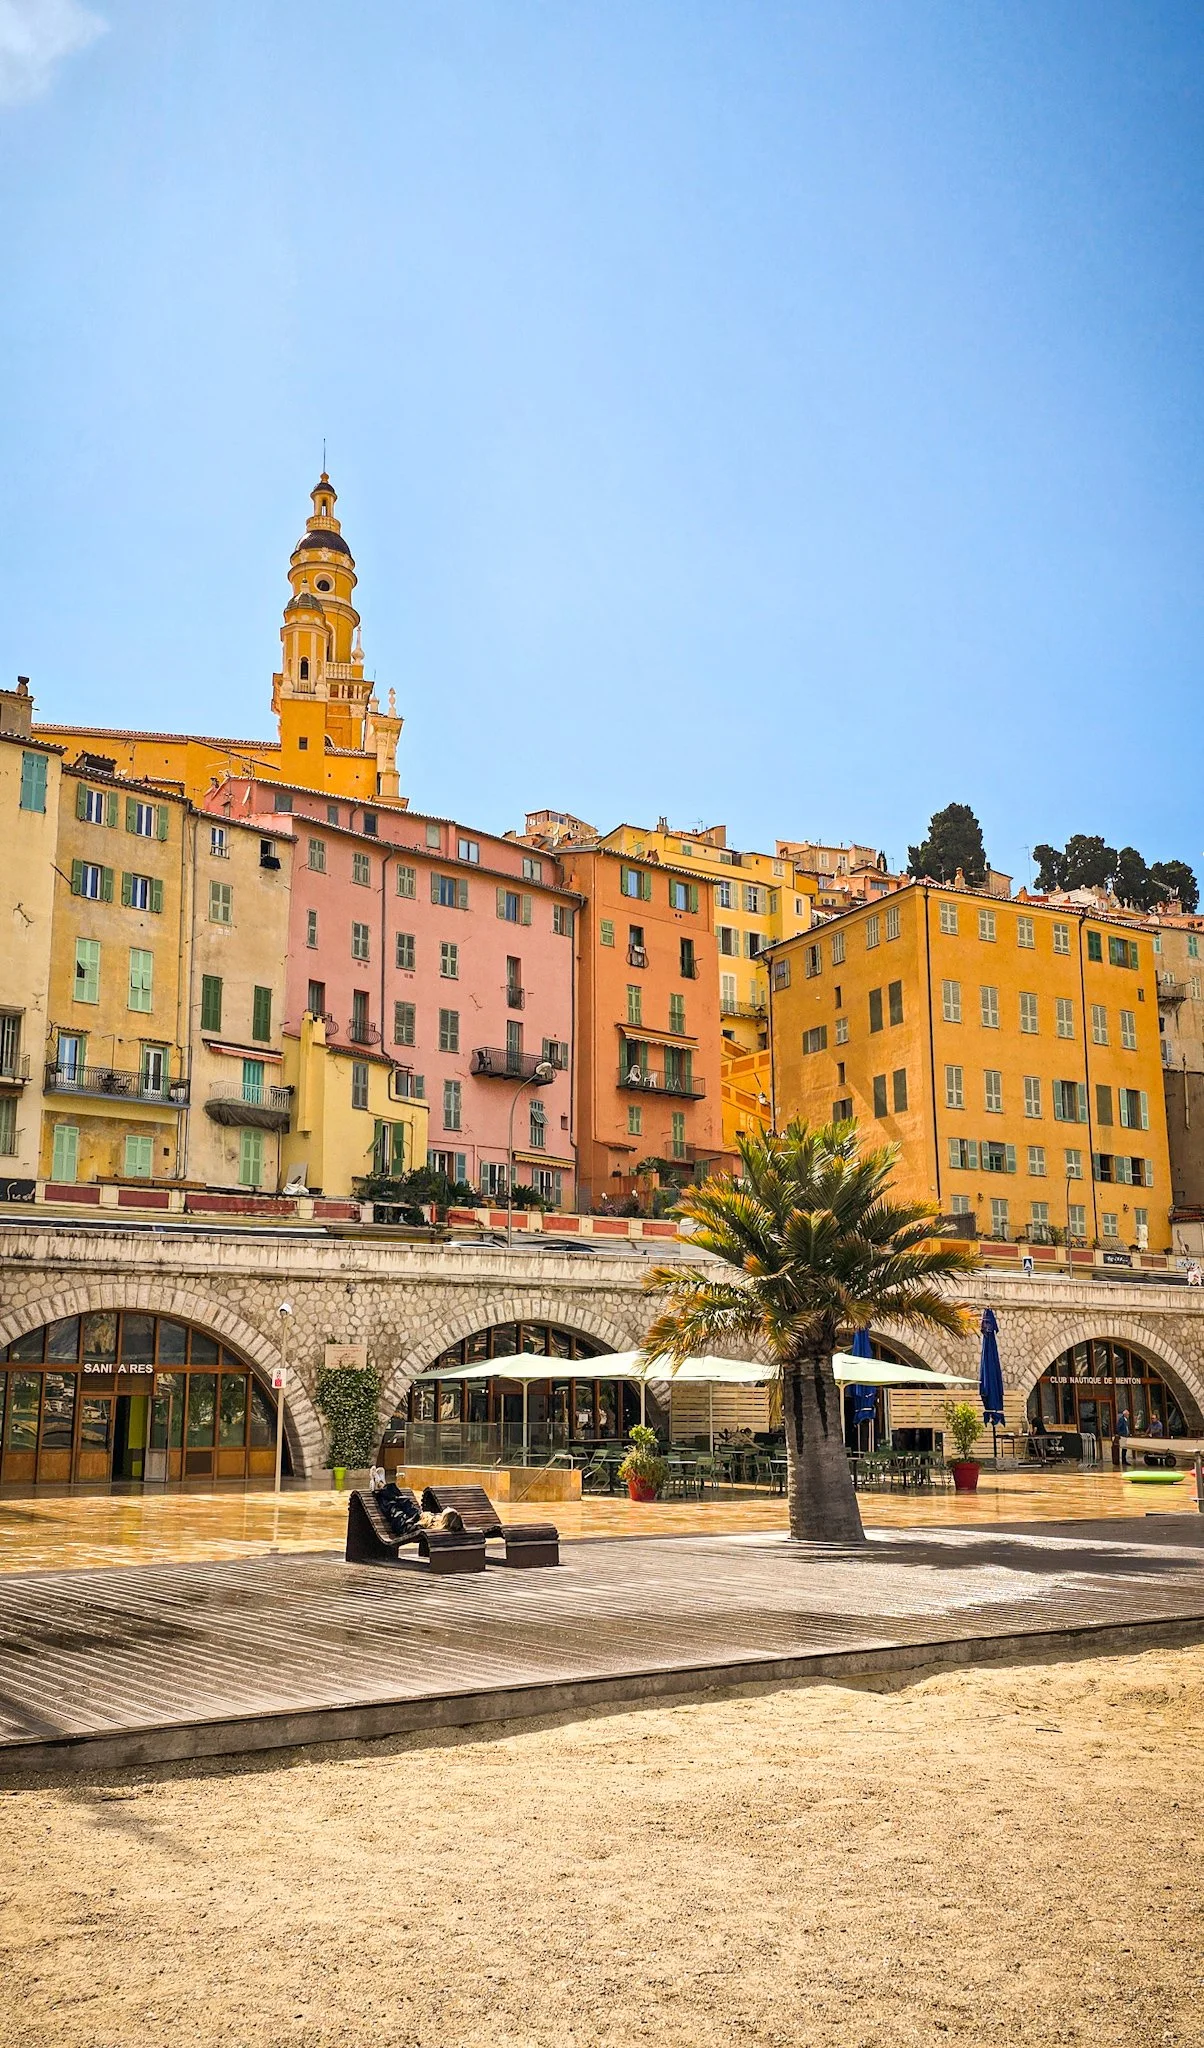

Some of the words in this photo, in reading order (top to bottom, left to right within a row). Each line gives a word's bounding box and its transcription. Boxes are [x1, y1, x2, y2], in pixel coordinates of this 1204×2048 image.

[1050, 1376, 1068, 1384] CLUB
[1070, 1376, 1102, 1385] NAUTIQUE
[1104, 1377, 1113, 1385] DE
[1116, 1377, 1141, 1386] MENTON
